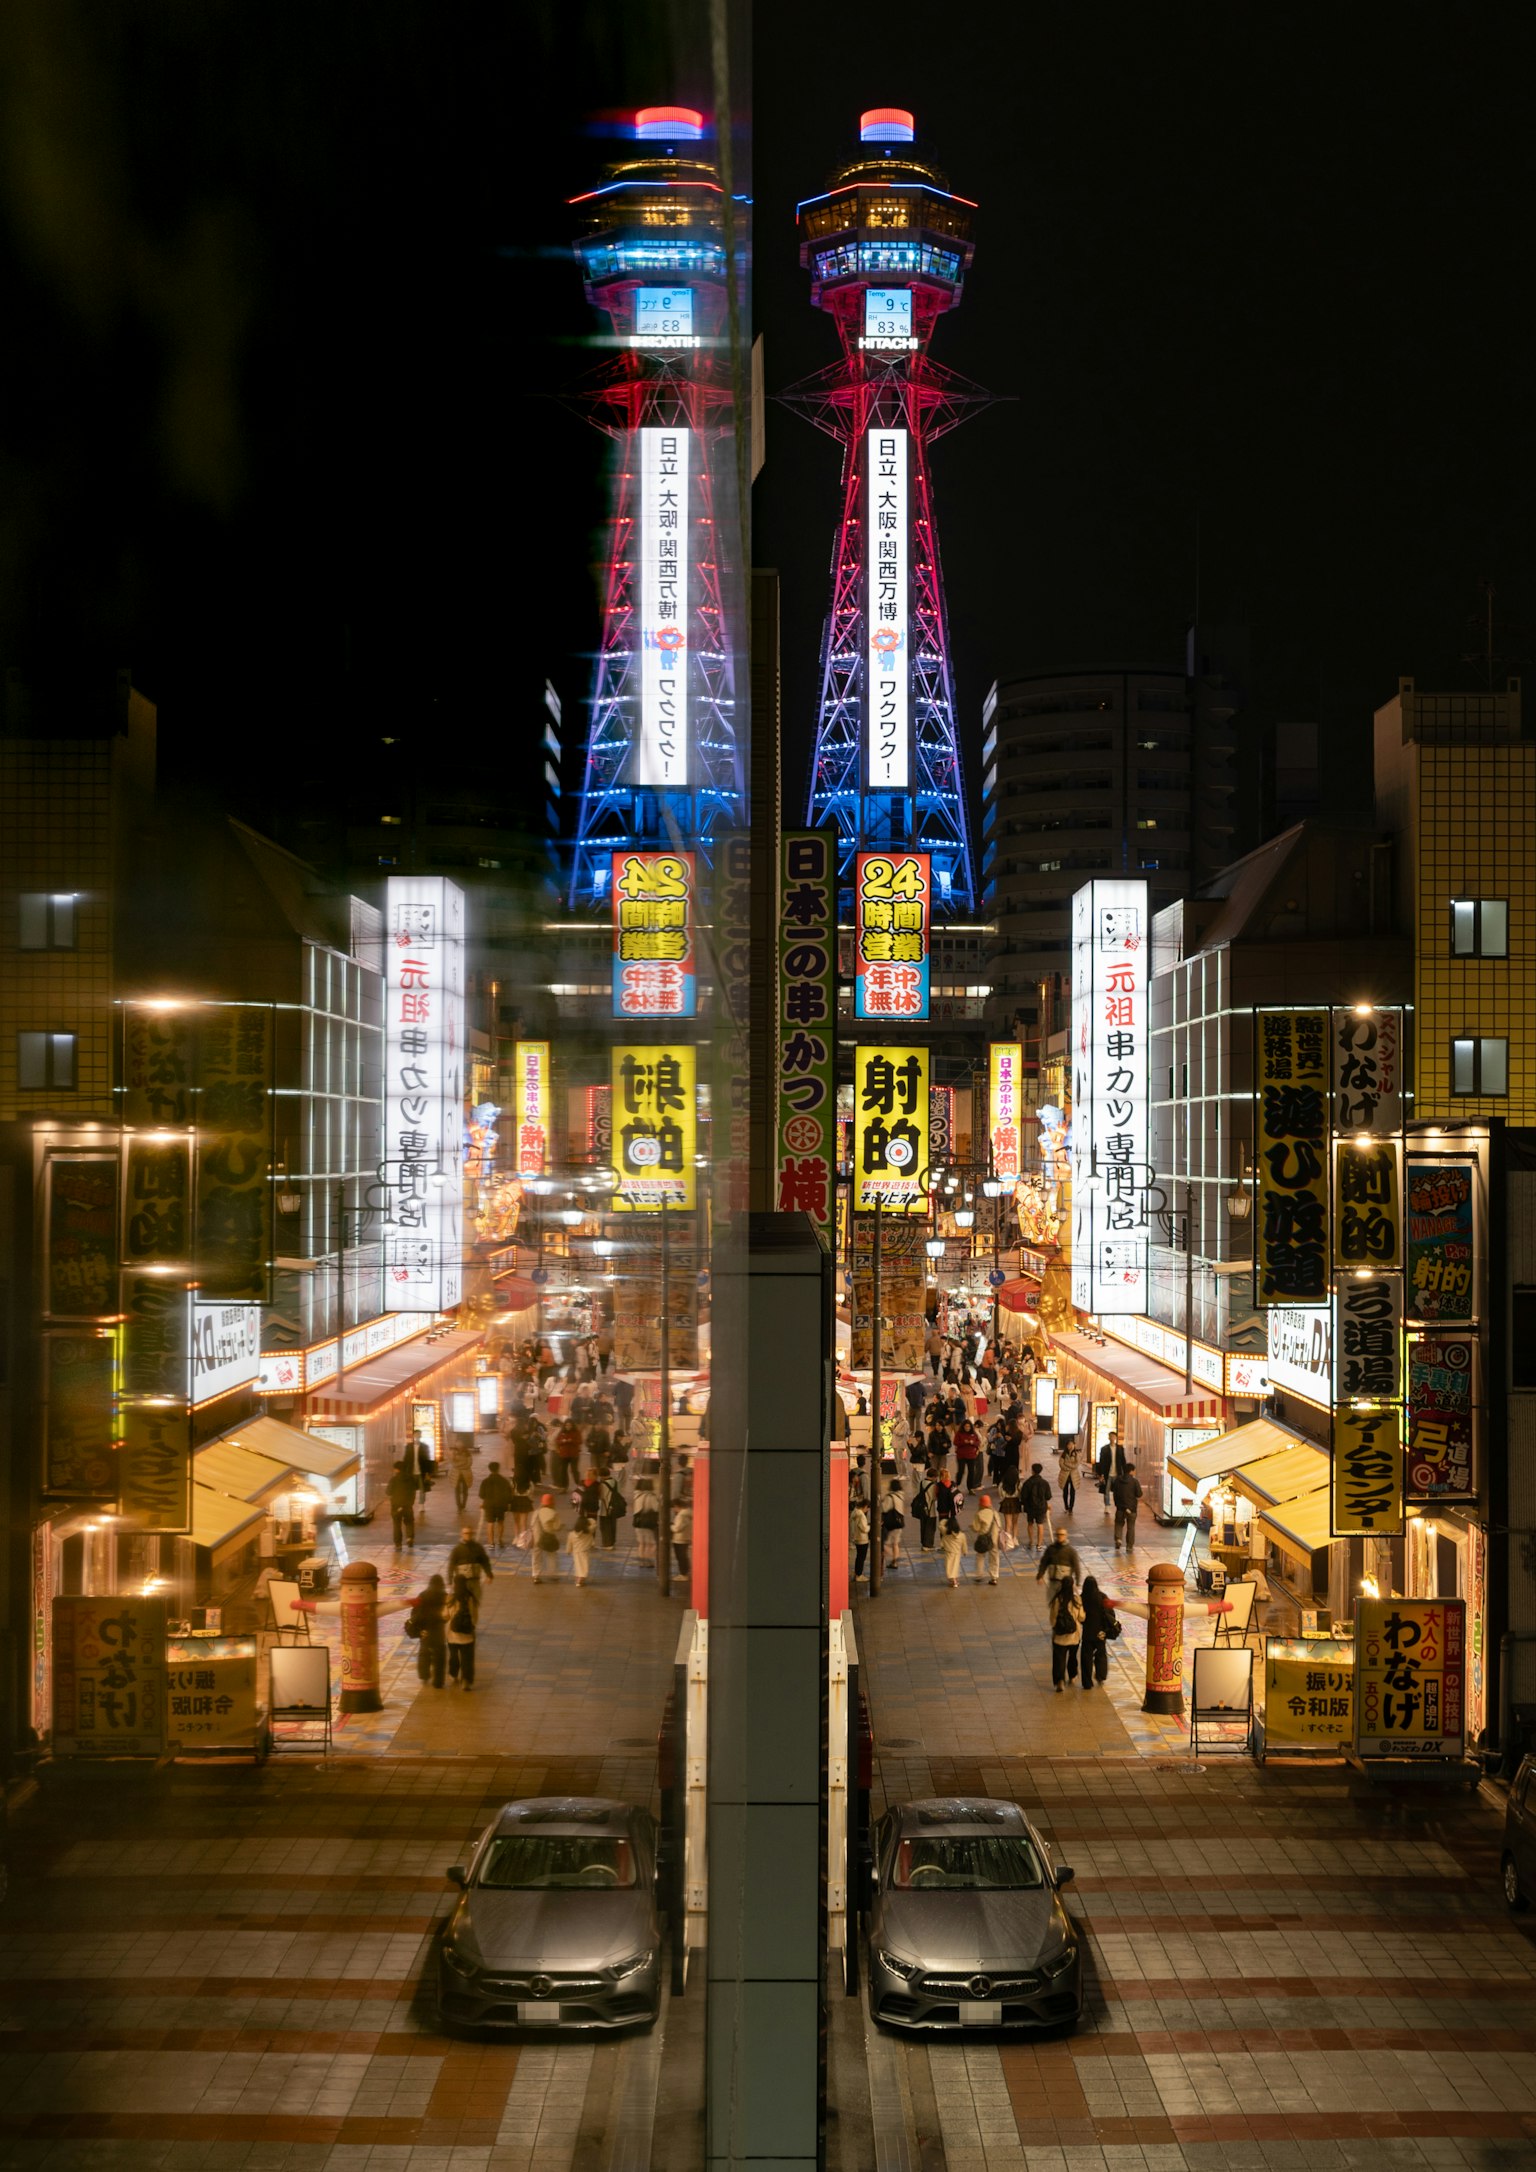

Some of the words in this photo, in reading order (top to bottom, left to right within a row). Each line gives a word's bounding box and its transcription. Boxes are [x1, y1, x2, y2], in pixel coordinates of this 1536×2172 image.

[877, 321, 895, 333] 83
[899, 325, 909, 333] %
[886, 299, 894, 311] 9
[858, 337, 918, 349] HITACHI
[877, 438, 898, 620] 日立、大阪・関西万博
[879, 680, 897, 778] ワクワク!
[863, 858, 924, 899] 24
[862, 901, 924, 930] 時間
[861, 931, 924, 962] 営業
[781, 839, 828, 1112] 日本一の串かつ
[868, 991, 918, 1012] 無休
[869, 967, 918, 989] 年中
[1263, 1016, 1293, 1080] 遊技場
[1295, 1016, 1325, 1080] 新世界一
[1338, 1014, 1382, 1129] わなげ
[1377, 1014, 1397, 1094] スペシャル
[861, 1054, 923, 1177] 射的
[998, 1057, 1013, 1127] 日本一の串かつ
[1104, 962, 1136, 1231] 元祖串カツ専門店
[1340, 1147, 1395, 1260] 射的
[1411, 1256, 1472, 1296] 射的
[1310, 1318, 1331, 1380] DX
[1412, 1420, 1449, 1464] 弓
[1341, 1411, 1396, 1528] ゲームセンター
[1420, 1609, 1441, 1661] 大人の
[1383, 1611, 1422, 1731] わなげ
[1288, 1696, 1349, 1717] 令和版
[1308, 1724, 1344, 1734] すぐそこ
[1425, 1681, 1438, 1729] 超ド迫力
[1421, 1741, 1444, 1753] DX
